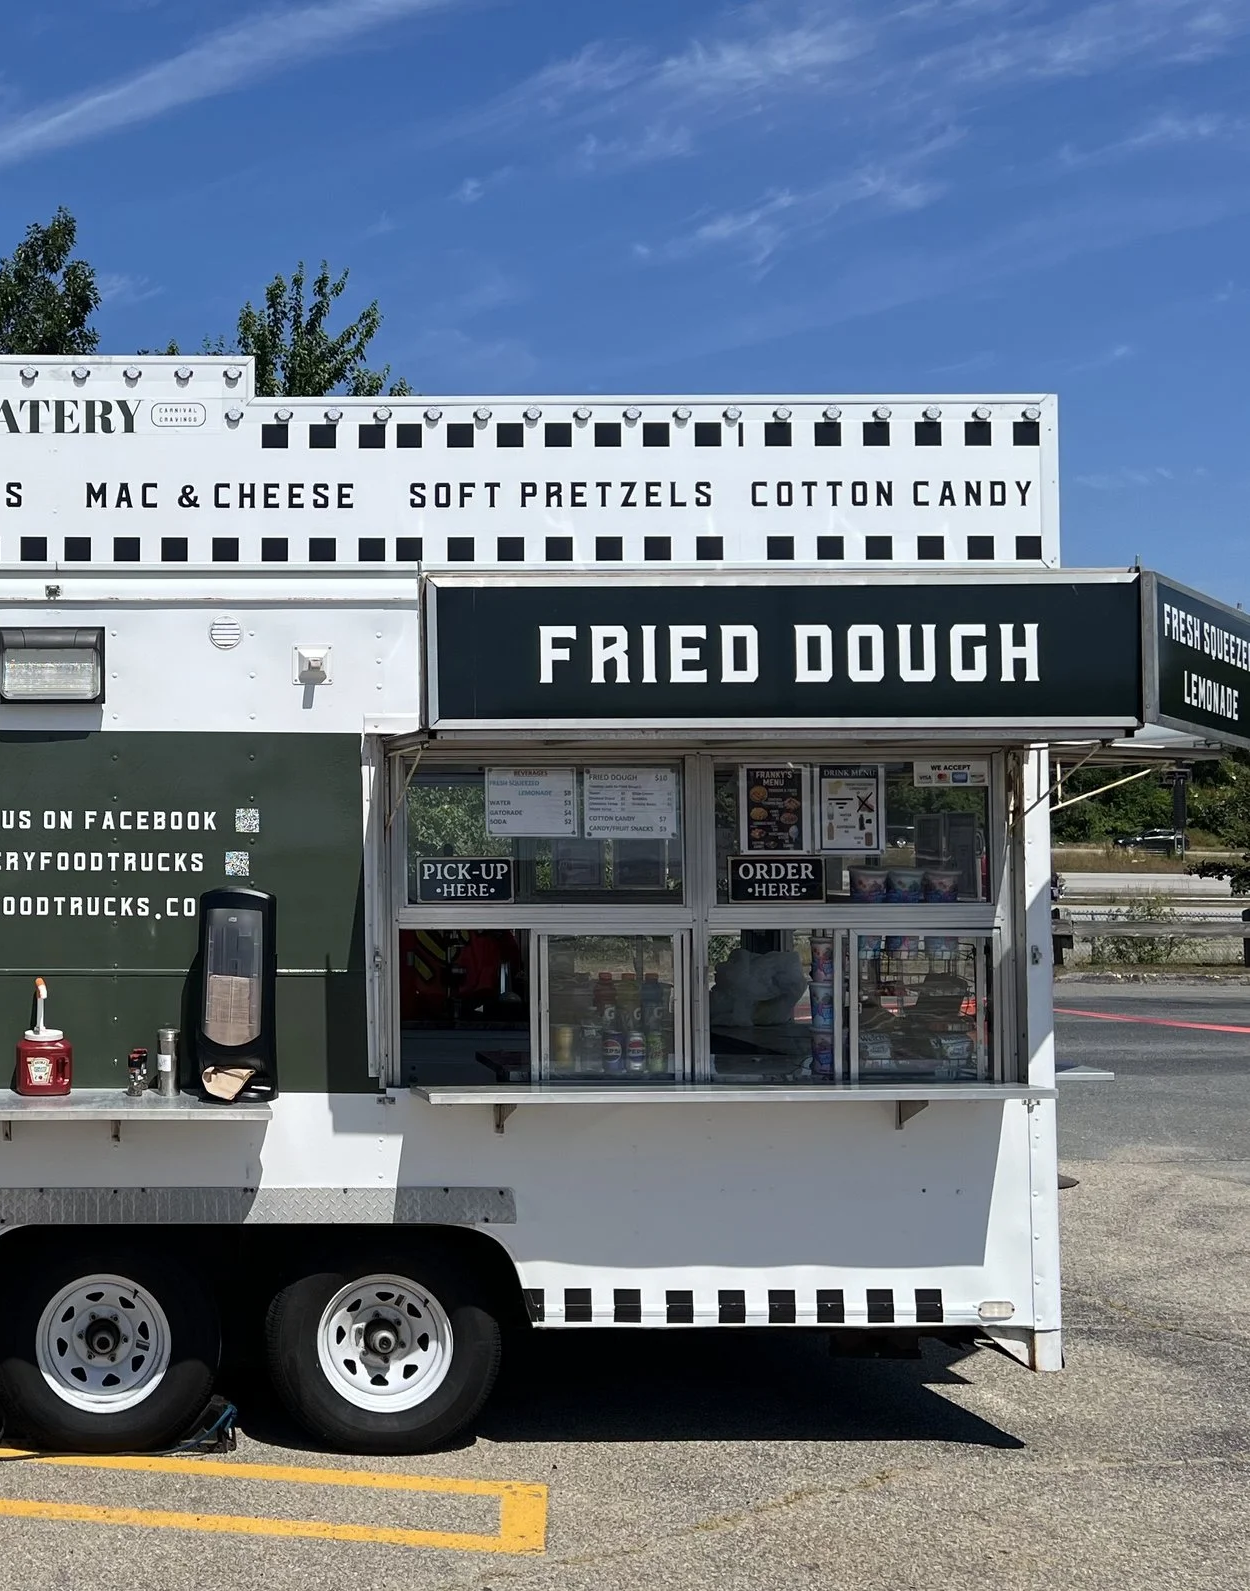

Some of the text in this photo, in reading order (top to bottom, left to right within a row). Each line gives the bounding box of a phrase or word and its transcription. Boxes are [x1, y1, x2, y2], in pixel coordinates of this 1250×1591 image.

[86, 483, 353, 508] MAC & CHEESE
[410, 482, 711, 508] SOFT PRETZELS
[752, 481, 1031, 506] COTTON CANDY
[1163, 602, 1201, 651] FRESH
[539, 624, 1039, 683] FRIED DOUGH
[1184, 670, 1239, 721] LEMONADE
[755, 771, 793, 779] FRANKY'S
[762, 778, 785, 786] MENU
[2, 811, 31, 828] US
[44, 811, 72, 829] ON
[85, 811, 216, 830] FACEBOOK
[423, 864, 507, 879] PICK-UP
[739, 863, 814, 879] ORDER
